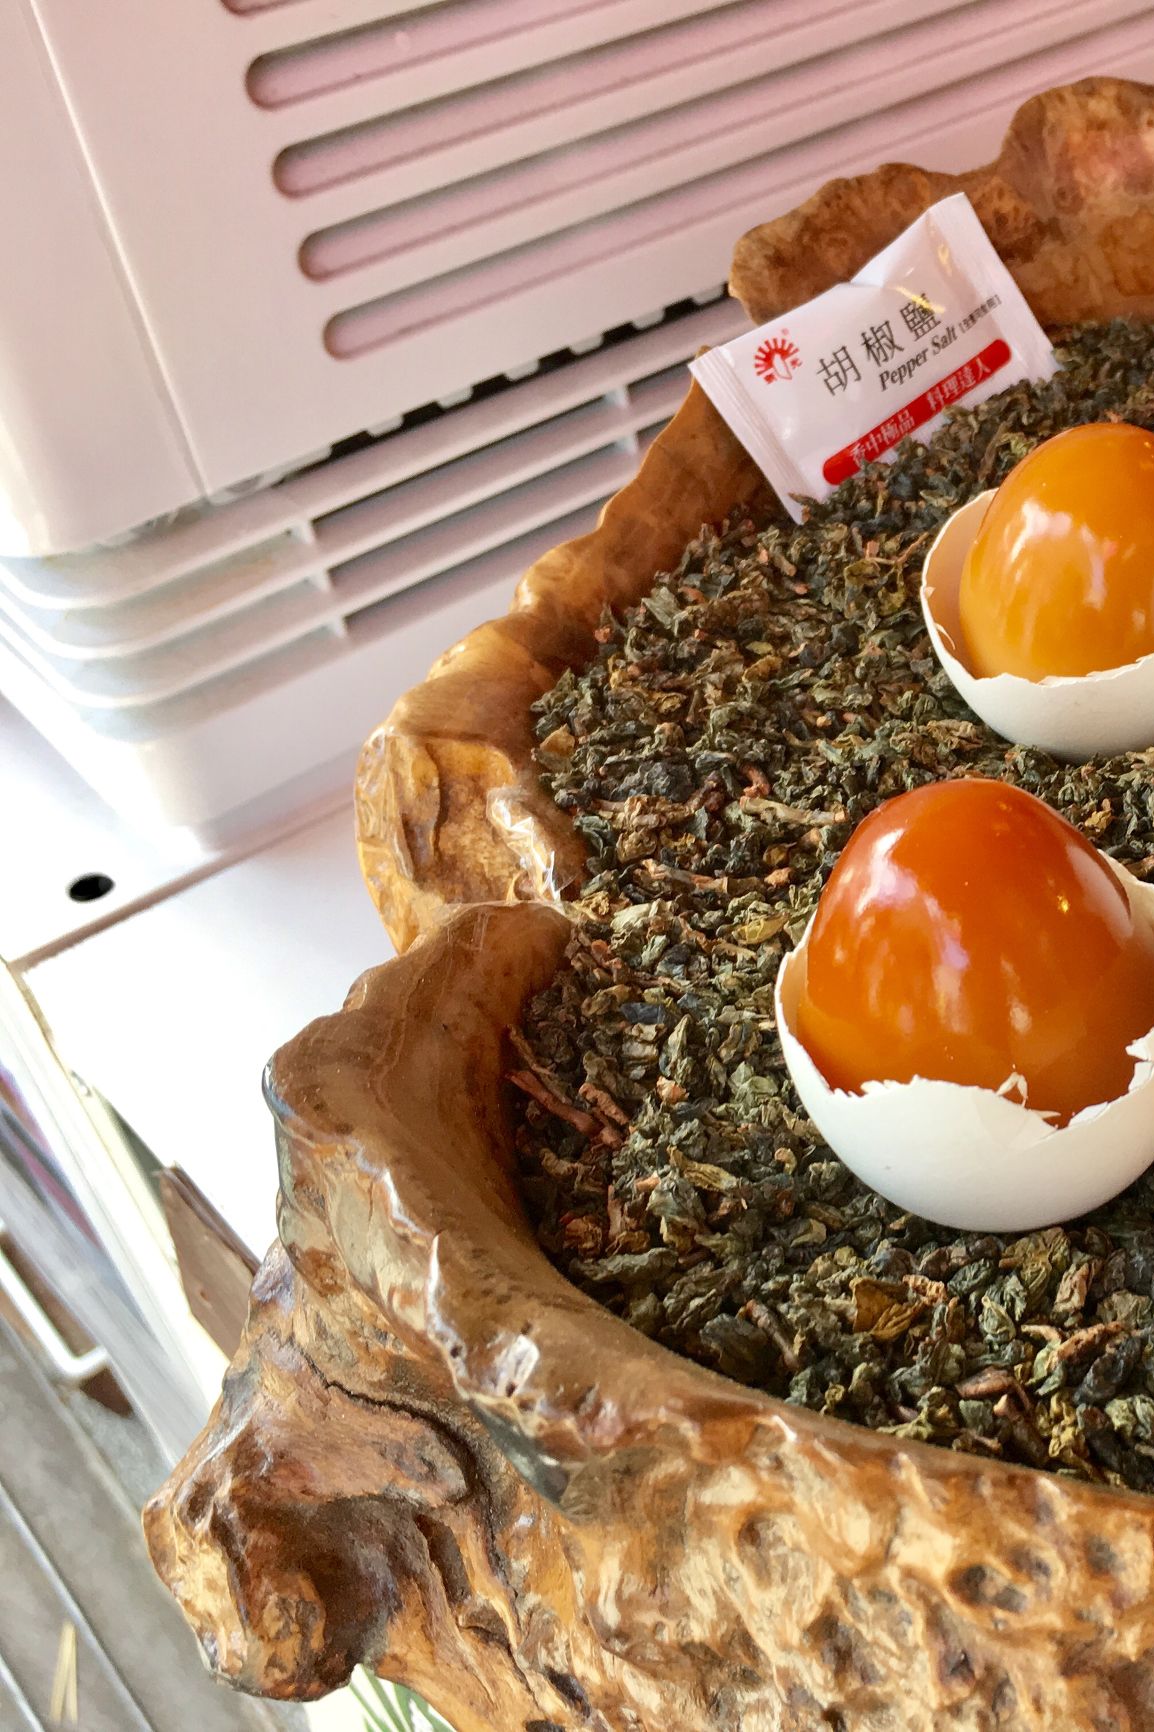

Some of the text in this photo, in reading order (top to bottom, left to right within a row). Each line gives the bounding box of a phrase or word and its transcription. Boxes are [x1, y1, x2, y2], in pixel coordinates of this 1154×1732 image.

[816, 293, 941, 396] 胡椒鹽
[879, 349, 930, 392] Pepper
[931, 326, 959, 357] Salt
[927, 362, 992, 411] 料理達人
